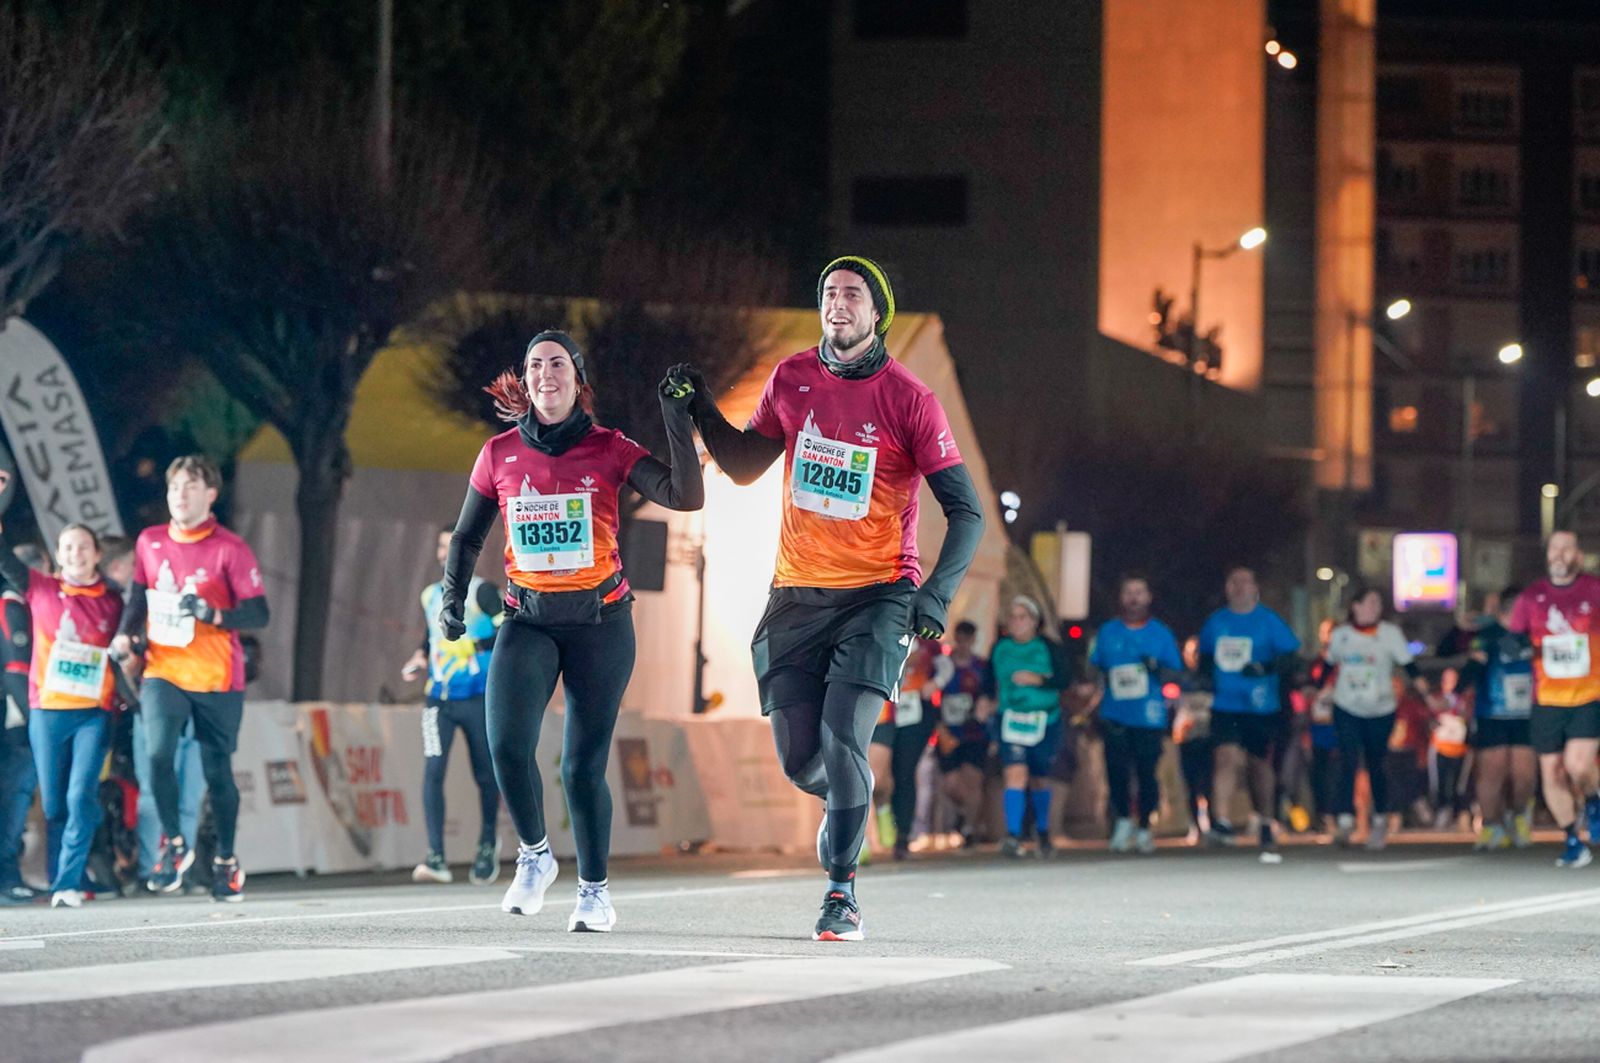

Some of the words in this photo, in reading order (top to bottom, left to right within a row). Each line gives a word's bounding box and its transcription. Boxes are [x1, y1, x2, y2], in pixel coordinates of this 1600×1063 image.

[802, 450, 818, 461] SAN
[811, 444, 835, 456] NOCHE
[836, 449, 846, 458] DE
[801, 461, 862, 495] 12845
[524, 503, 548, 512] NOCHE
[549, 502, 560, 511] DE
[515, 513, 532, 522] SAN
[517, 520, 582, 546] 13352
